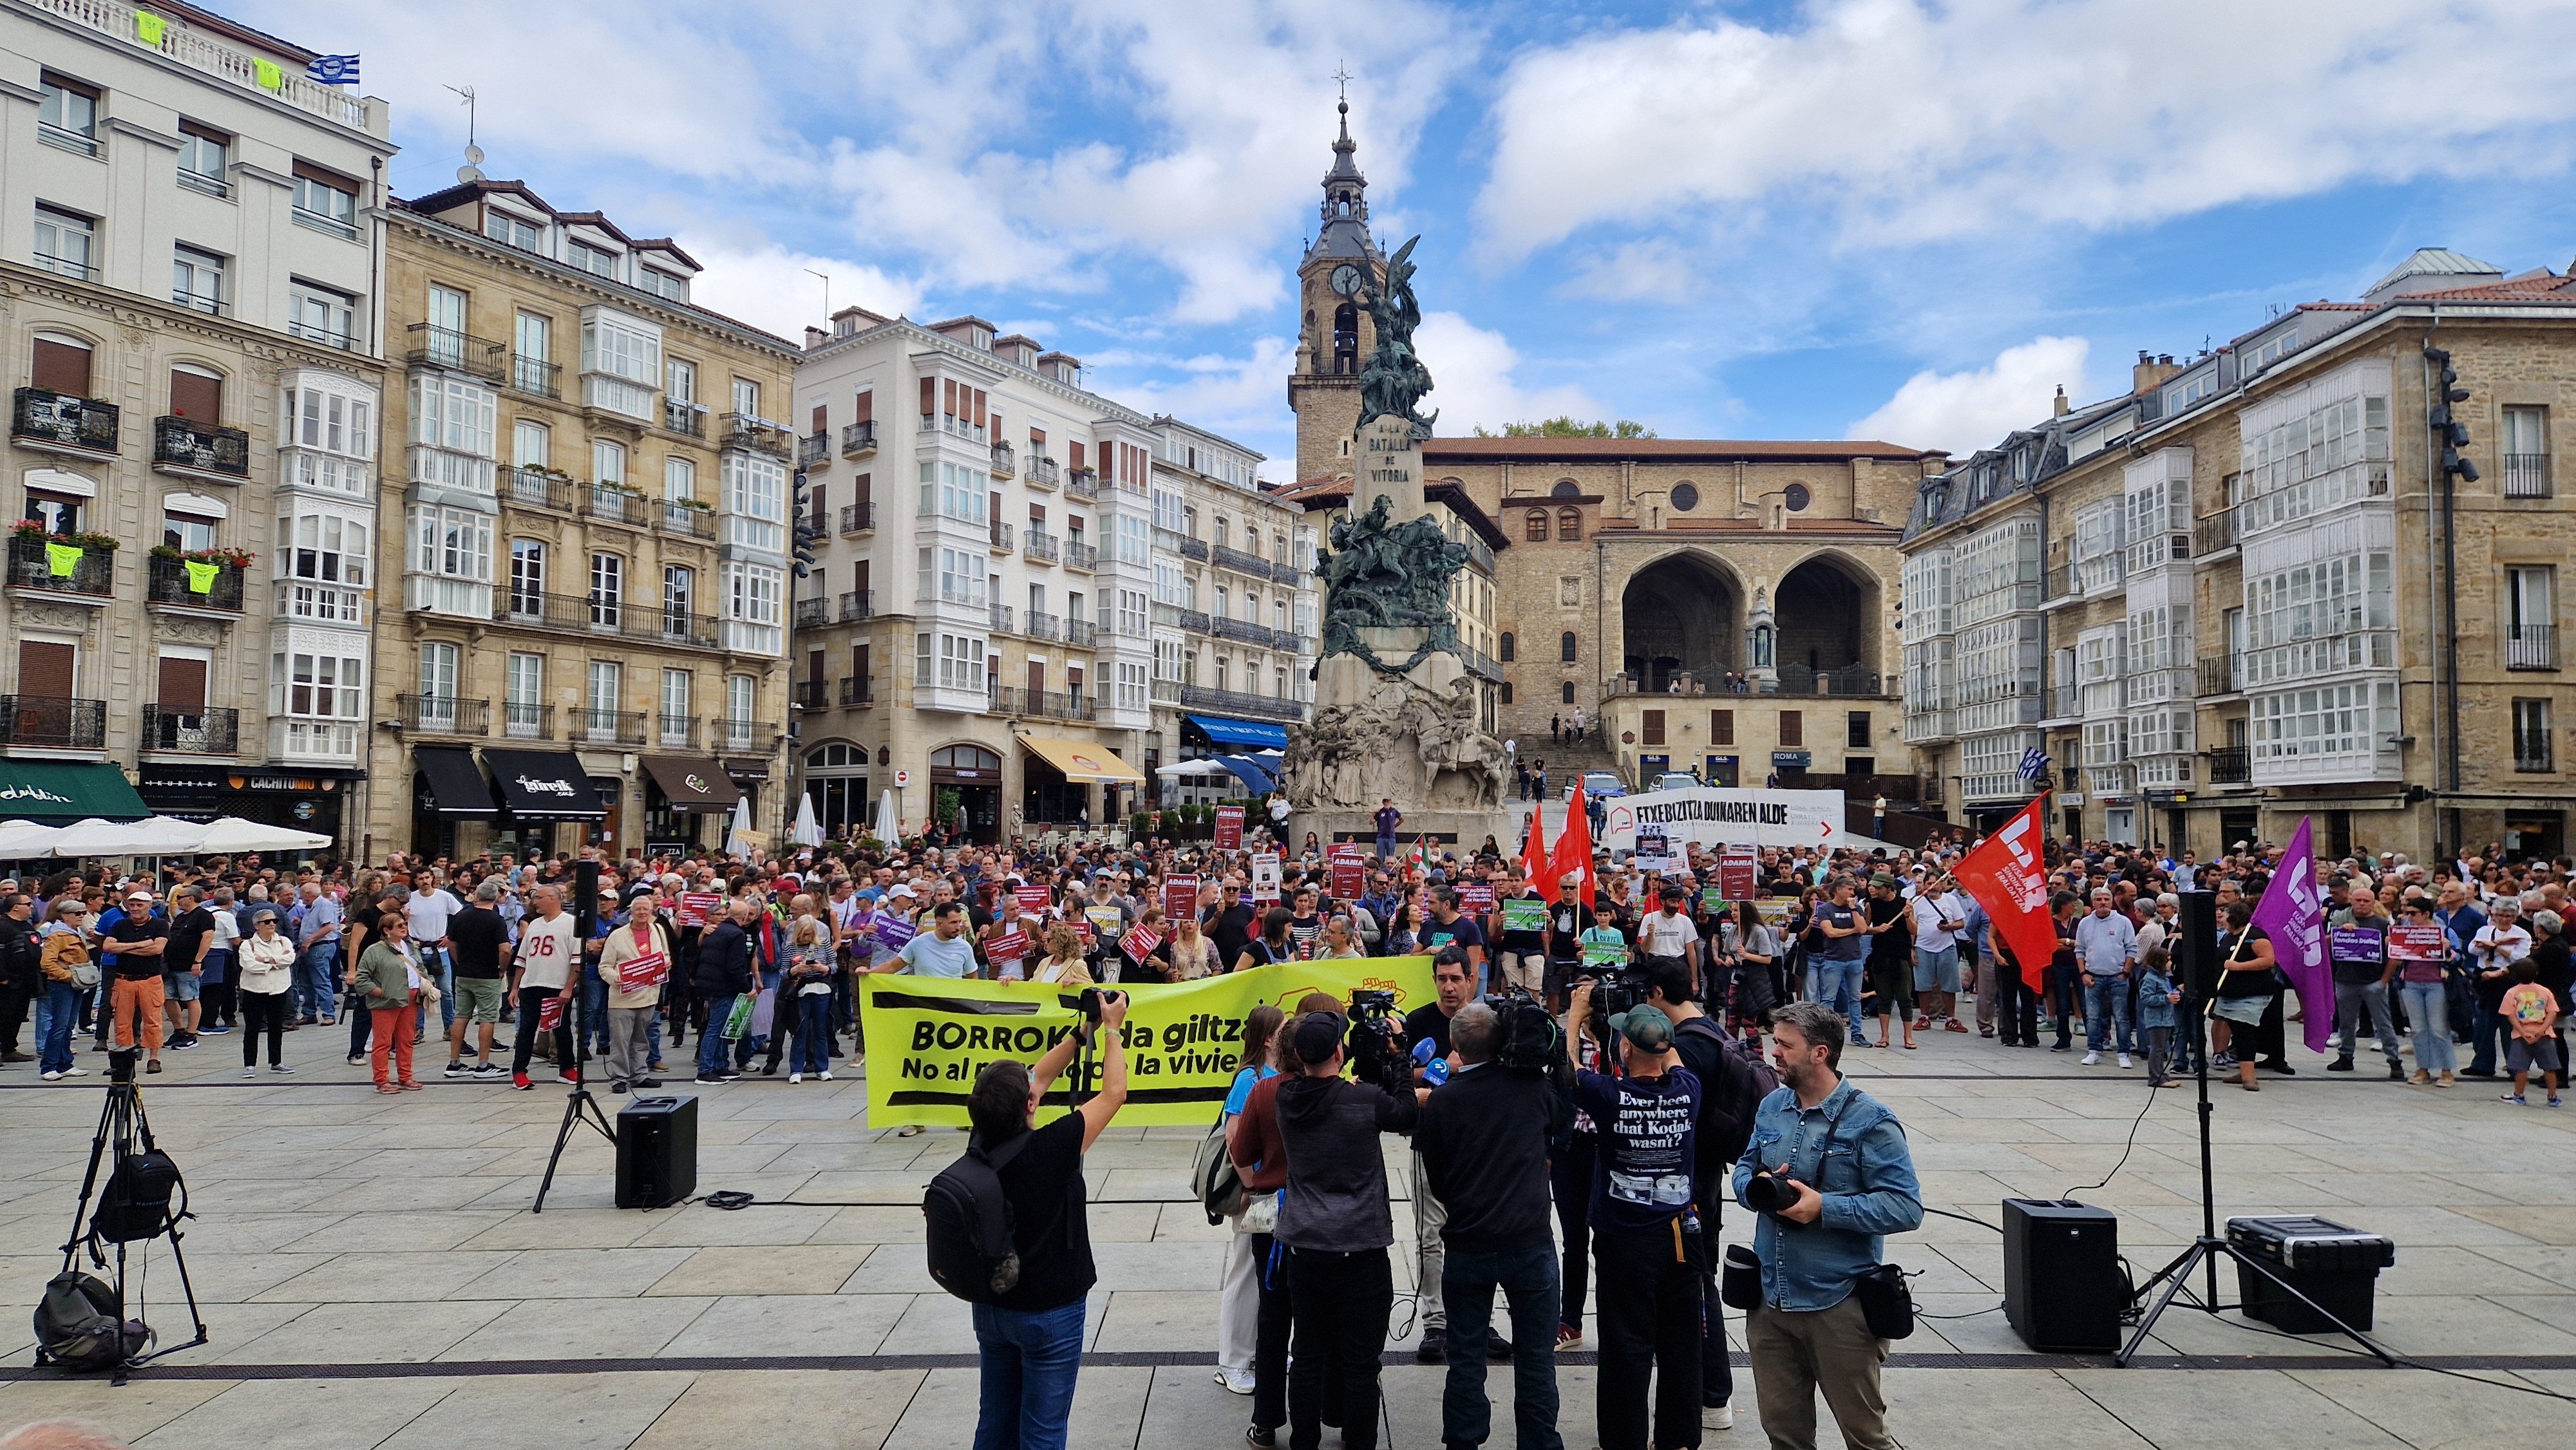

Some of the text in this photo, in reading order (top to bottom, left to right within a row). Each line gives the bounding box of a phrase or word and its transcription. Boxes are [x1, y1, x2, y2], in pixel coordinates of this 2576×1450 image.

[1370, 438, 1412, 451] BATALLA
[1386, 456, 1395, 465] DE
[1372, 469, 1409, 482] VITORIA
[0, 784, 73, 803] dublin
[1705, 802, 1757, 824] DUINAREN
[1759, 803, 1788, 825] ALDE
[2008, 862, 2029, 888] EUSKA
[529, 935, 554, 957] 36
[911, 1021, 1097, 1053] BORROK
[902, 1057, 939, 1080] No
[945, 1057, 970, 1081] al
[1134, 1053, 1161, 1076] la
[1168, 1048, 1244, 1075] vivie
[1618, 1090, 1691, 1107] Ever been
[1619, 1107, 1689, 1124] anywhere
[1613, 1118, 1692, 1135] that Kodak
[1629, 1133, 1683, 1149] wasn't?
